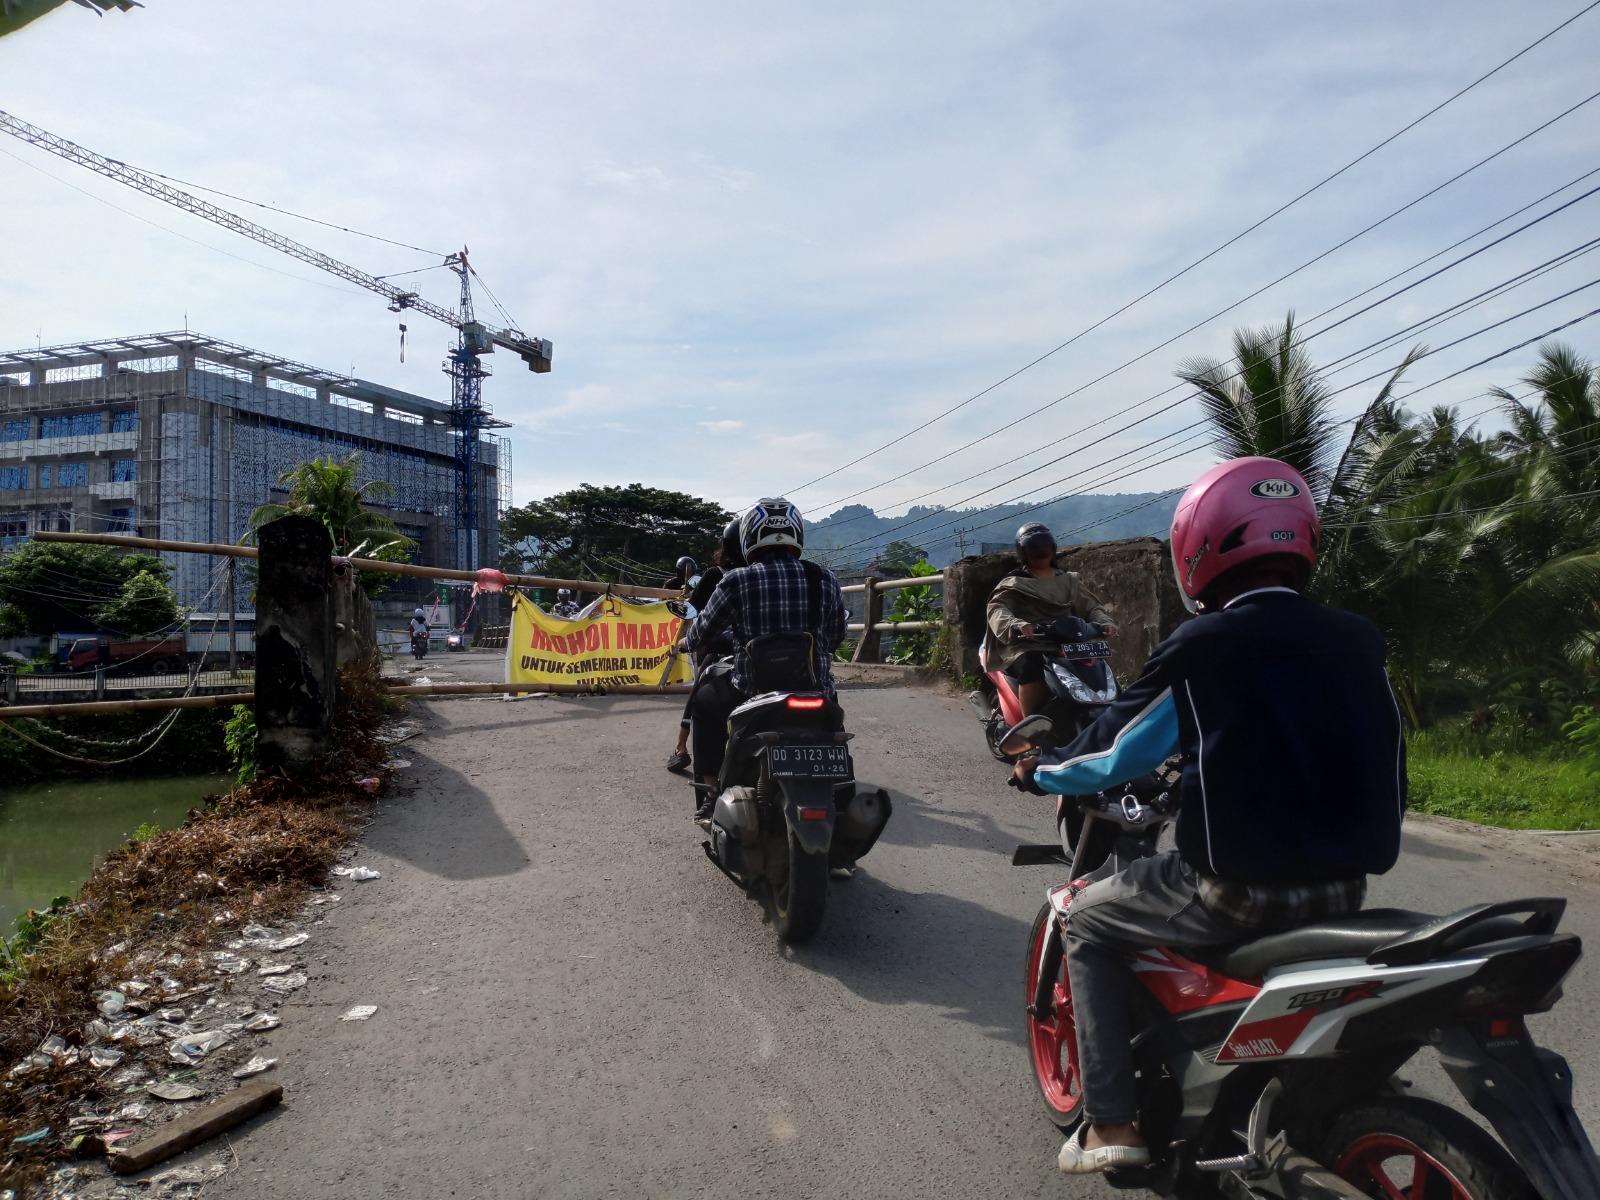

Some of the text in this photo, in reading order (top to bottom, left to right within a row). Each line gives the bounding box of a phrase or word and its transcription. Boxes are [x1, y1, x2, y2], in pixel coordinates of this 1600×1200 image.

[1272, 532, 1292, 541] DOT
[521, 655, 568, 674] UNTUK
[773, 749, 787, 761] DD
[795, 749, 822, 761] 3123
[1229, 1041, 1254, 1057] Satu
